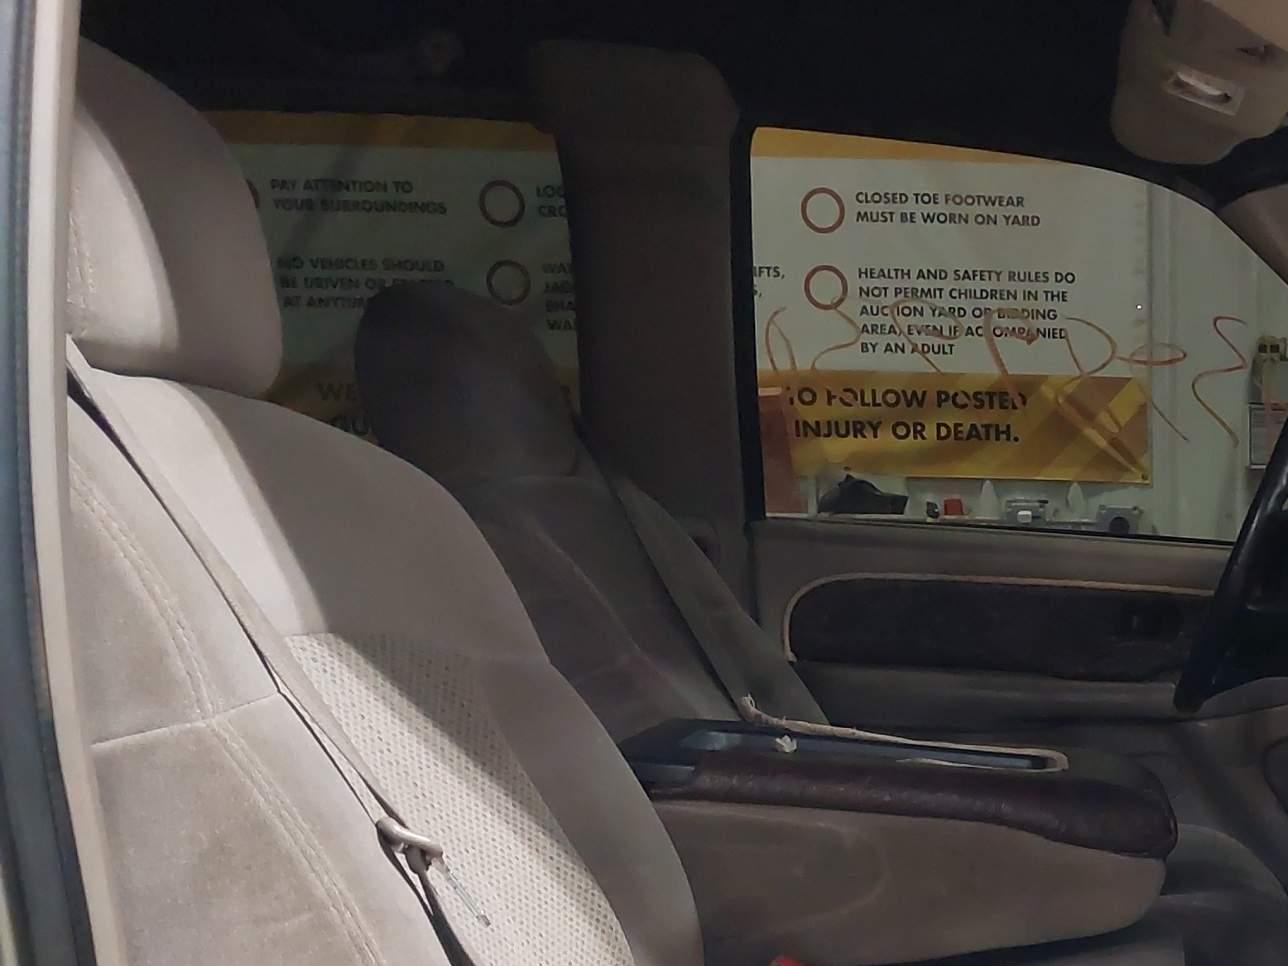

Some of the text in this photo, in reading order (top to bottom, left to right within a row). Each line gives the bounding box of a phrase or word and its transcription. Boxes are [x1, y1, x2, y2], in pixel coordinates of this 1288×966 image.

[270, 178, 413, 193] PAY ATTENTION TO
[272, 198, 447, 215] YOUR SURROUNDINGS
[855, 192, 1025, 208] CLOSED TOE FOOTWEAR
[856, 211, 1041, 227] MUST BE WORN ON YARD
[277, 256, 445, 272] NO VEHICLES SHOULD
[303, 277, 361, 289] DRIVEN
[858, 267, 1076, 284] HEALTH AND SAFETY RULES DO
[283, 296, 302, 309] AT
[859, 286, 1069, 303] NOT PERMIT CHILDREN IN THE
[860, 305, 924, 317] AUCION
[929, 306, 967, 318] YARD
[996, 308, 1058, 320] BDING
[861, 322, 902, 337] AREA,
[964, 326, 1067, 339] ACOMPANIED
[861, 342, 957, 356] BY AN ADULT
[826, 388, 928, 409] FOLLOW
[936, 390, 1028, 410] POSTED
[794, 419, 1019, 442] INJURY OR DEATH.
